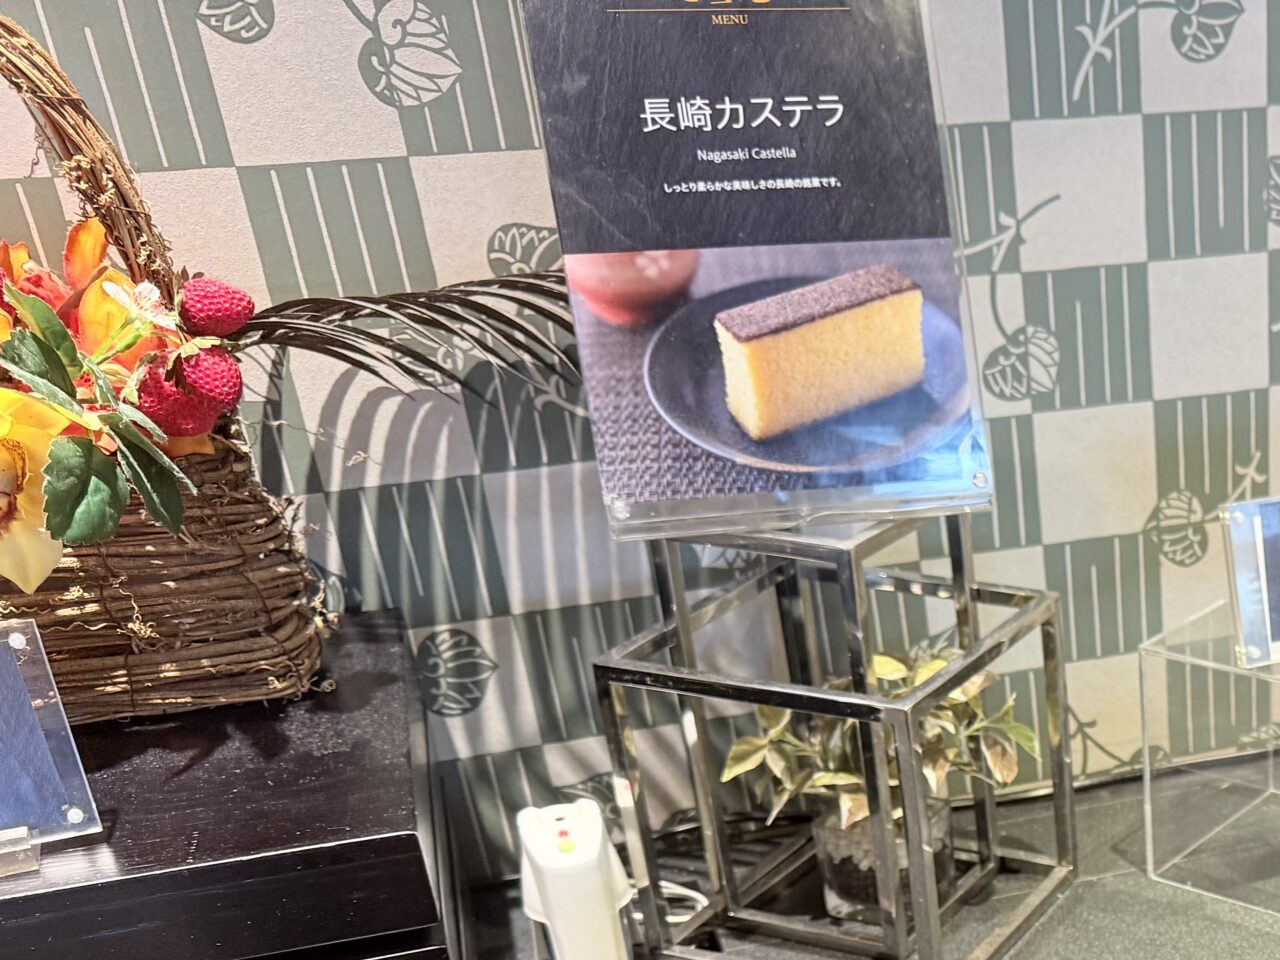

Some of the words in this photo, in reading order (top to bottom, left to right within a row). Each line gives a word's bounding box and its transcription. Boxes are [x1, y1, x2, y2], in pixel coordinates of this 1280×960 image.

[711, 14, 749, 25] MENU
[640, 95, 845, 132] 長崎カステラ
[697, 148, 749, 163] Nagasaki
[752, 147, 797, 160] Castella
